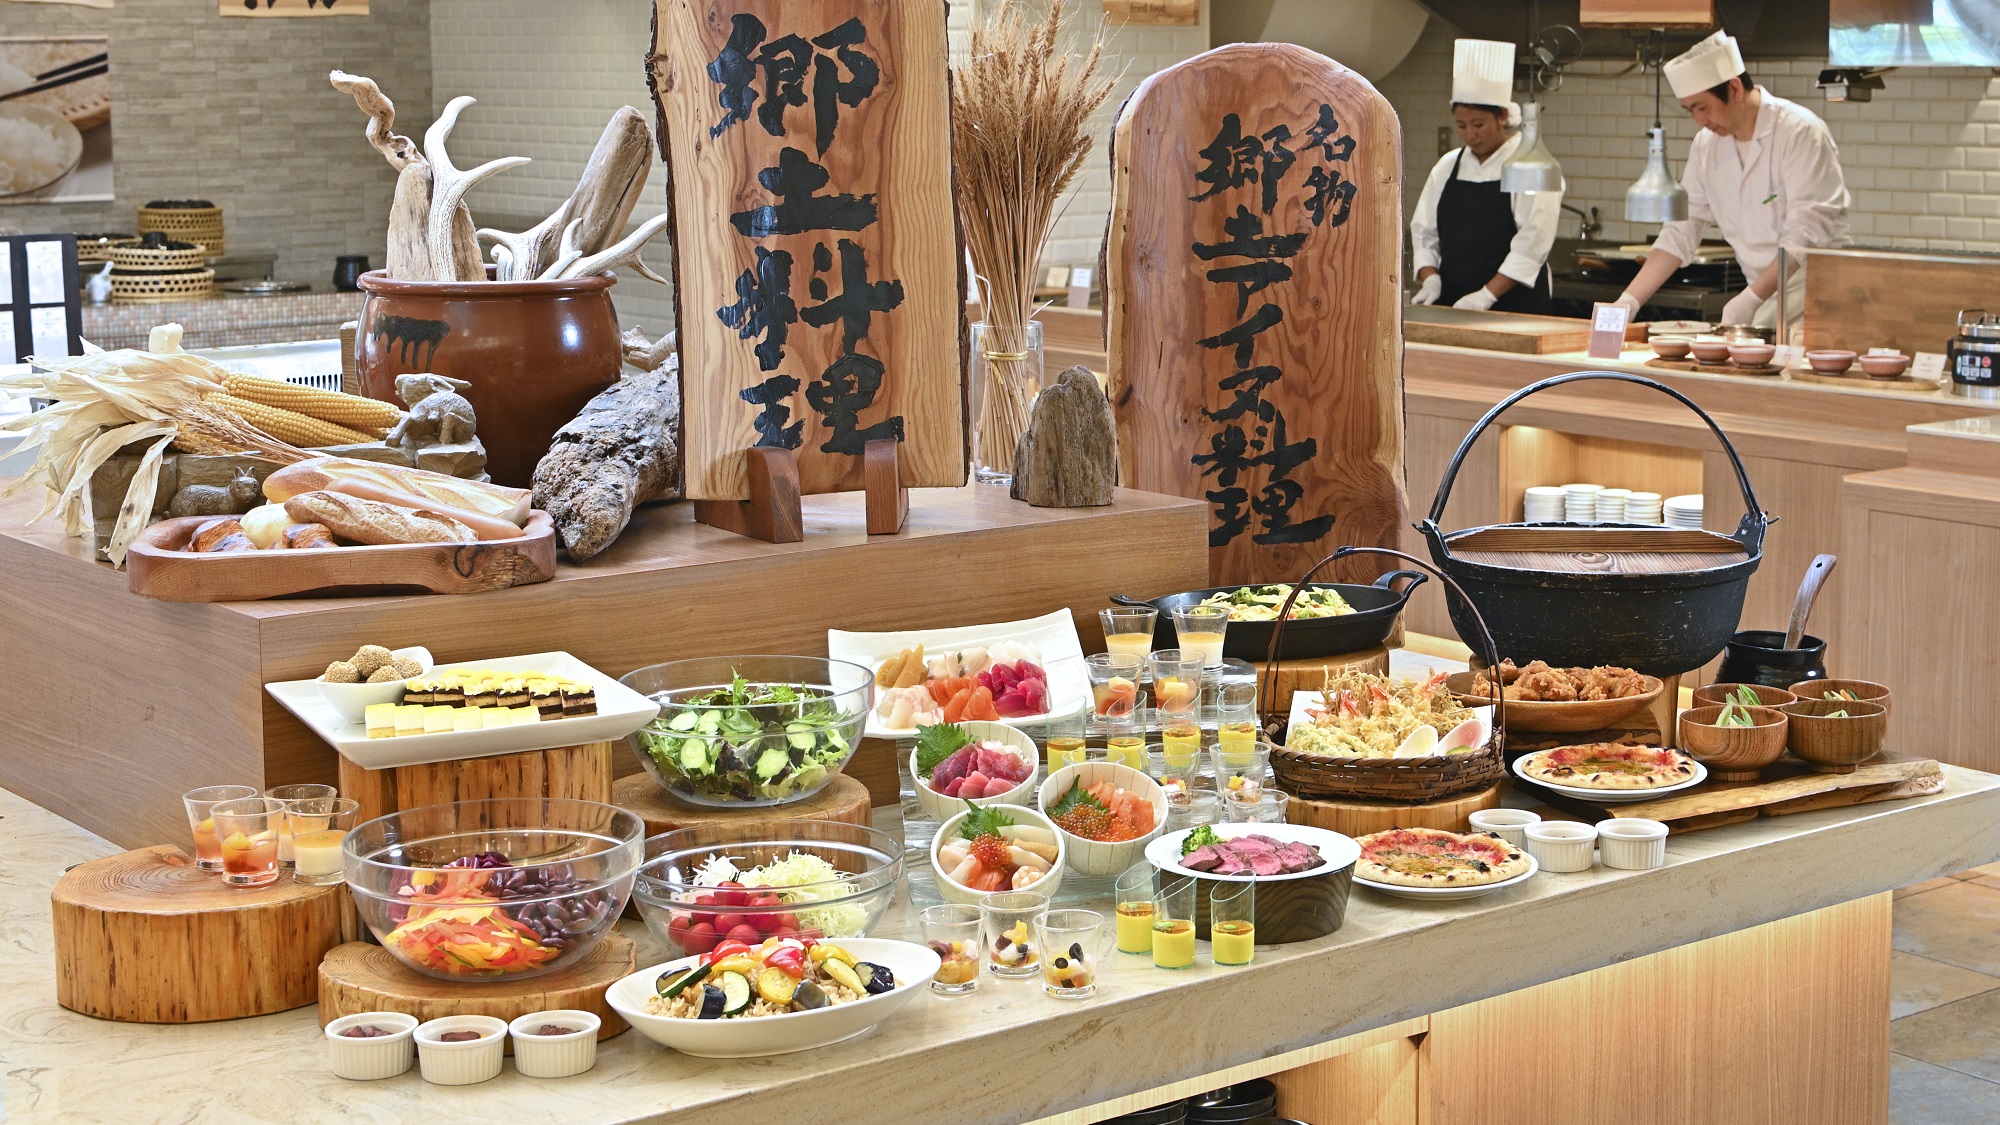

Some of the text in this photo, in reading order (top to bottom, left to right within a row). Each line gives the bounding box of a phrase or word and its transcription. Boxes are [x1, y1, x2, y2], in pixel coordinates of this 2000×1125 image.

[1149, 3, 1166, 14] food
[707, 13, 904, 456] 郷土料理
[1301, 103, 1357, 228] 名物
[1188, 112, 1335, 548] 郷土アイヌ料理
